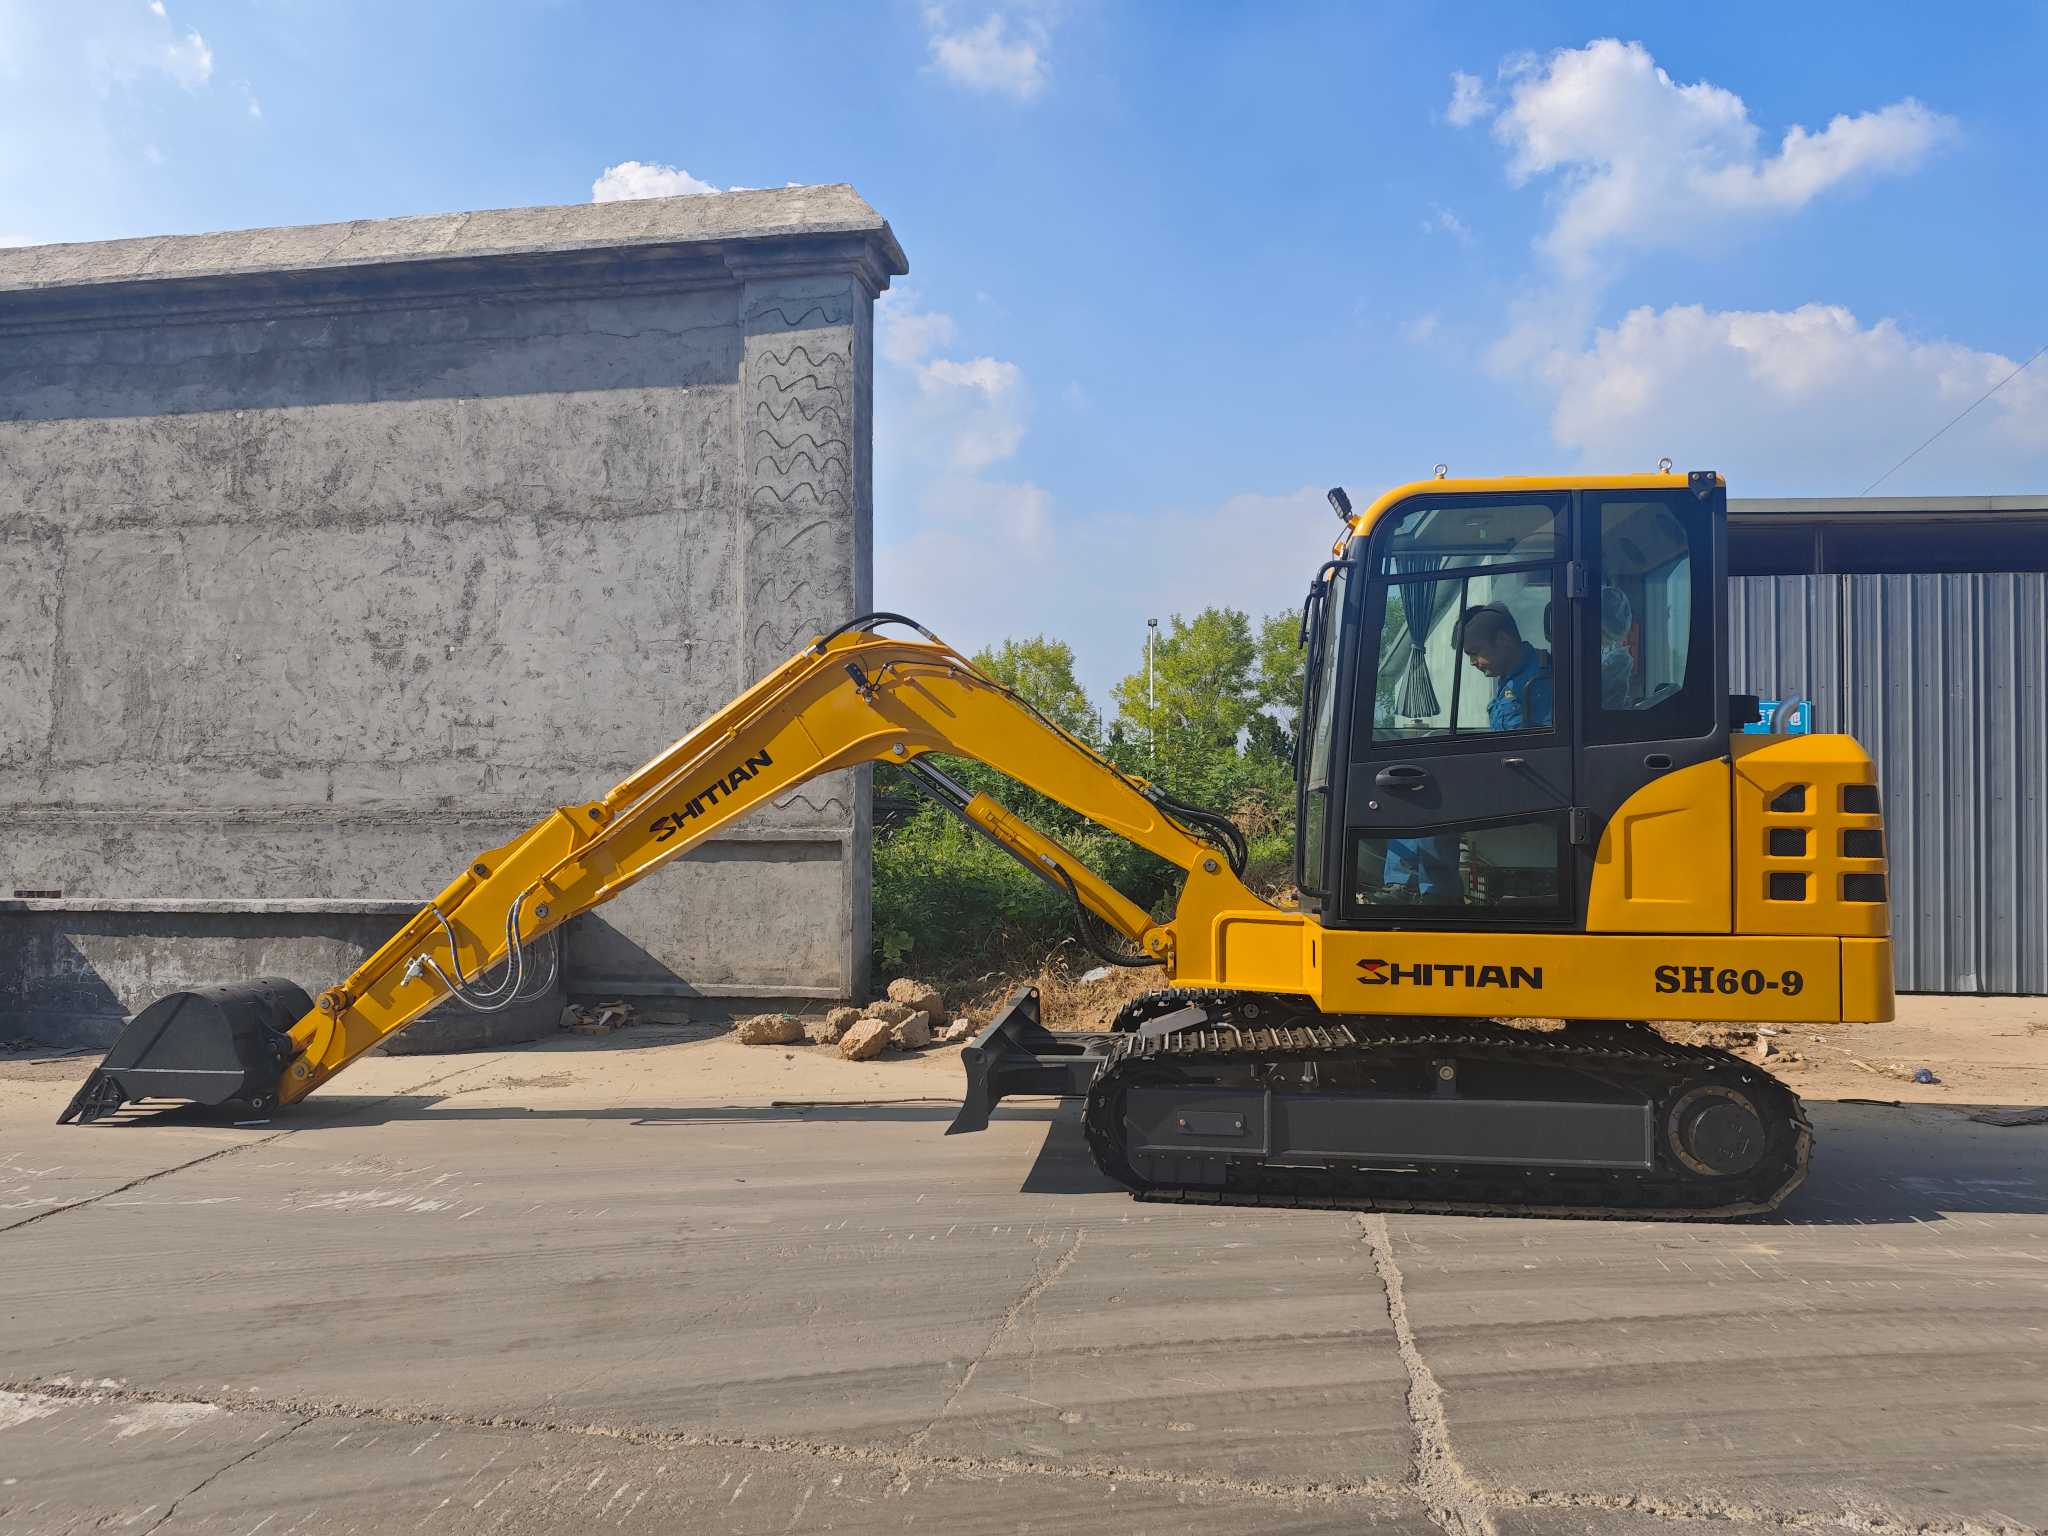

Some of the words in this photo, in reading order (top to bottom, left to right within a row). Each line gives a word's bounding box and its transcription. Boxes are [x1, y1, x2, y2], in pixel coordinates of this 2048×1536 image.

[649, 749, 773, 841] SHITIAN
[1357, 959, 1542, 989] SHITIAN
[1655, 966, 1804, 996] SH60-9
